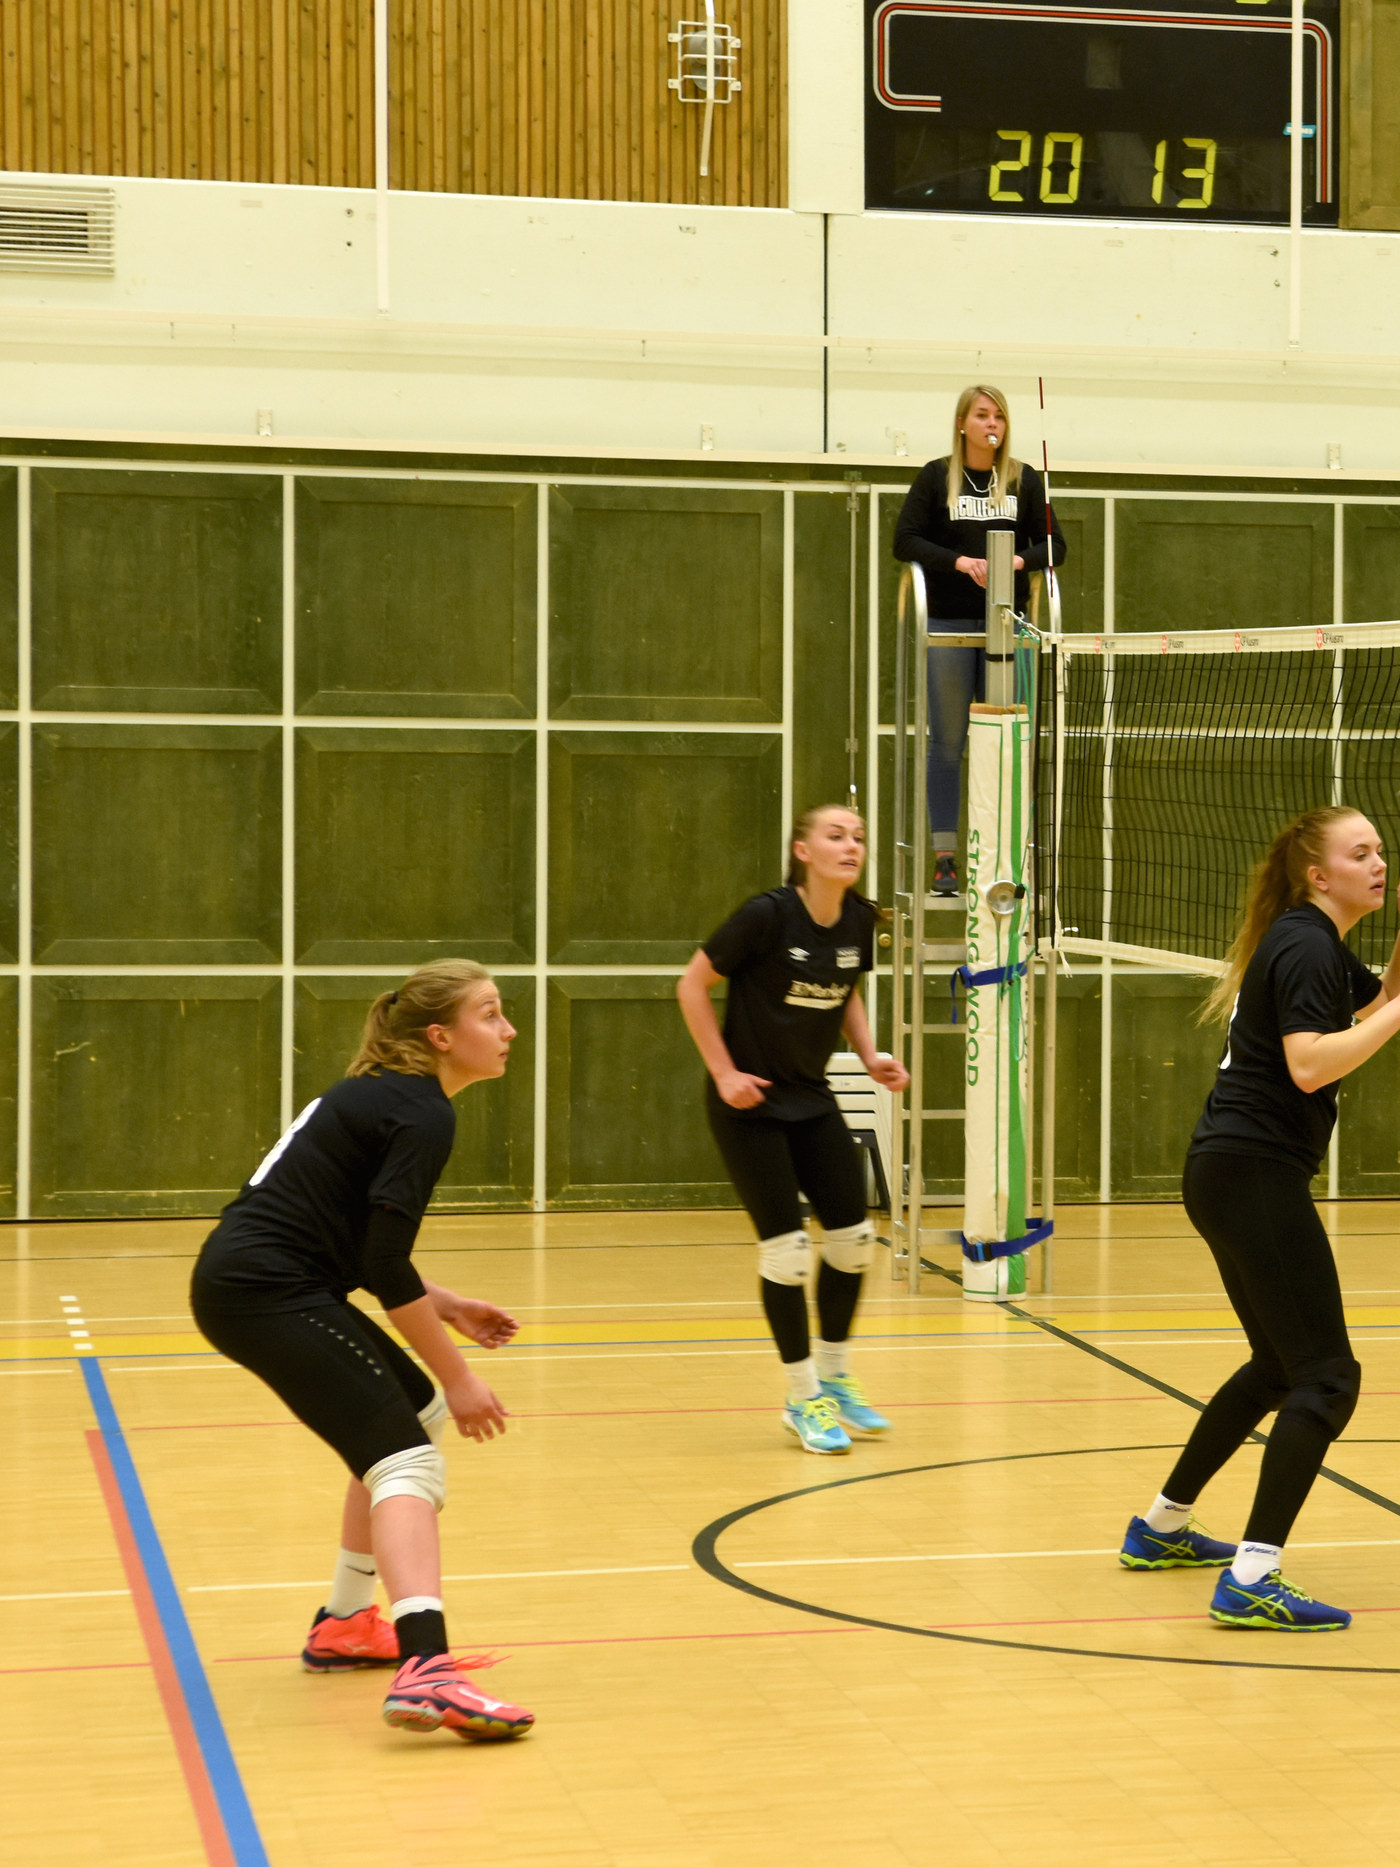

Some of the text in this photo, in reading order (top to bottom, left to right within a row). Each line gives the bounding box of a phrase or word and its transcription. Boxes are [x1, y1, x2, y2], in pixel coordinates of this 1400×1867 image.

[989, 130, 1217, 208] 20 13
[967, 829, 980, 1087] STRONG WOOD
